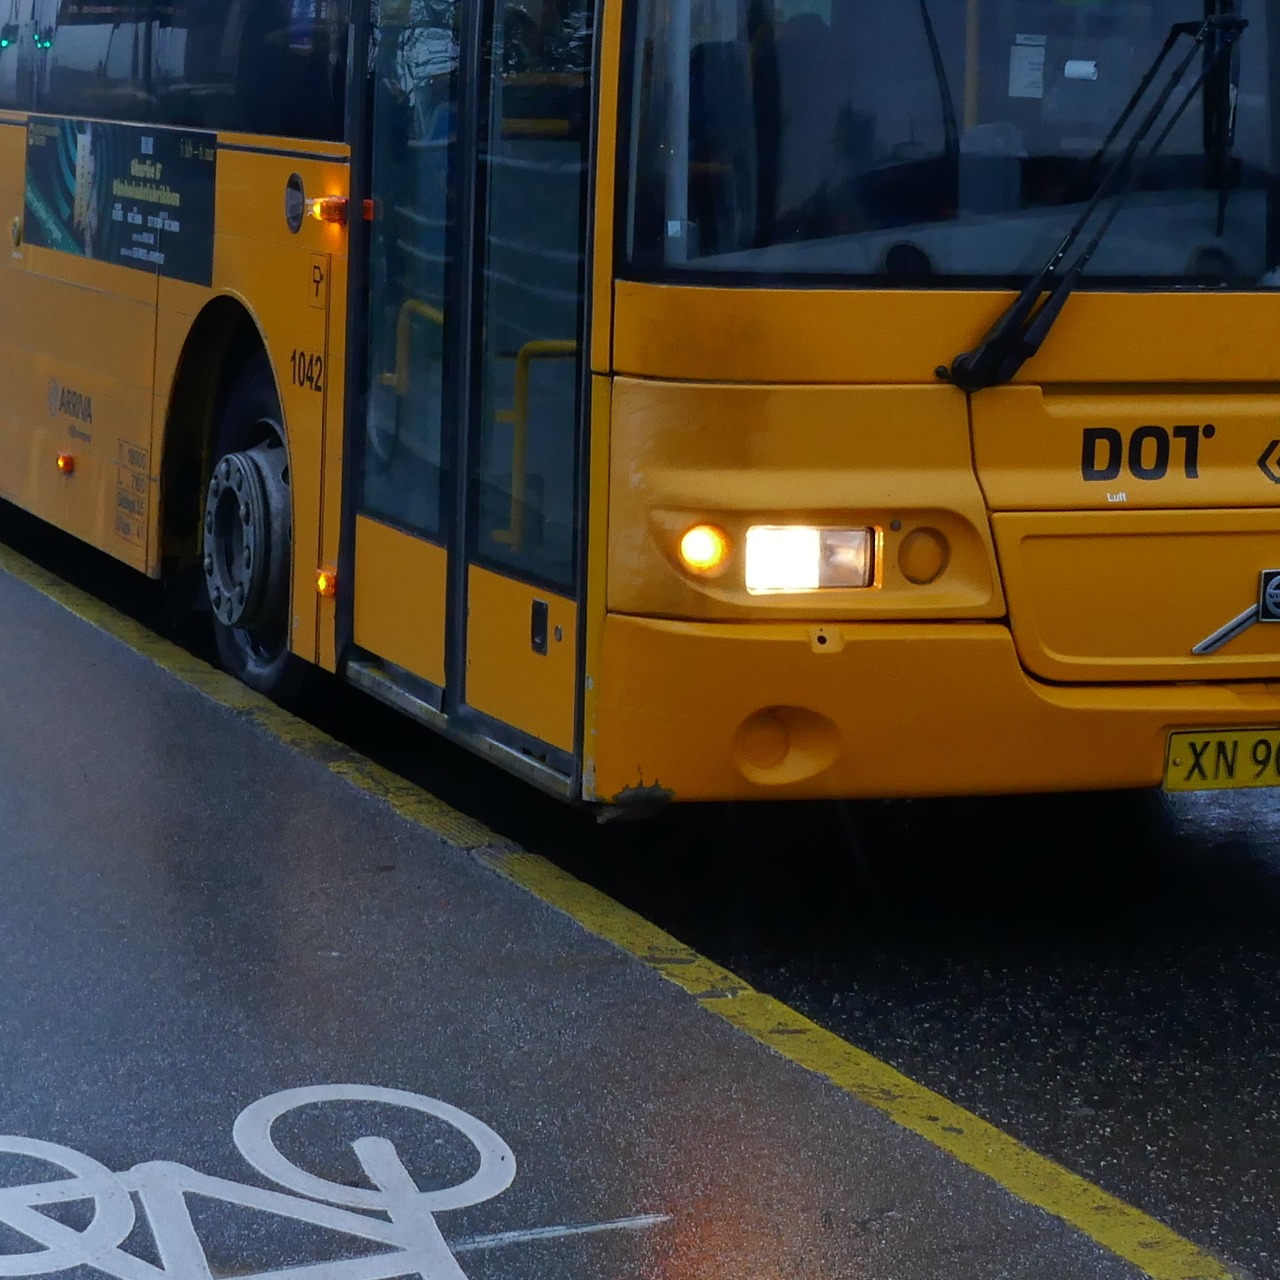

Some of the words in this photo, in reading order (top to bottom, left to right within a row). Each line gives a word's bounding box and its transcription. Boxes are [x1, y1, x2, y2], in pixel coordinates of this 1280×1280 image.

[290, 349, 323, 393] 1042
[1081, 423, 1216, 482] DOT
[1183, 740, 1239, 781] XN
